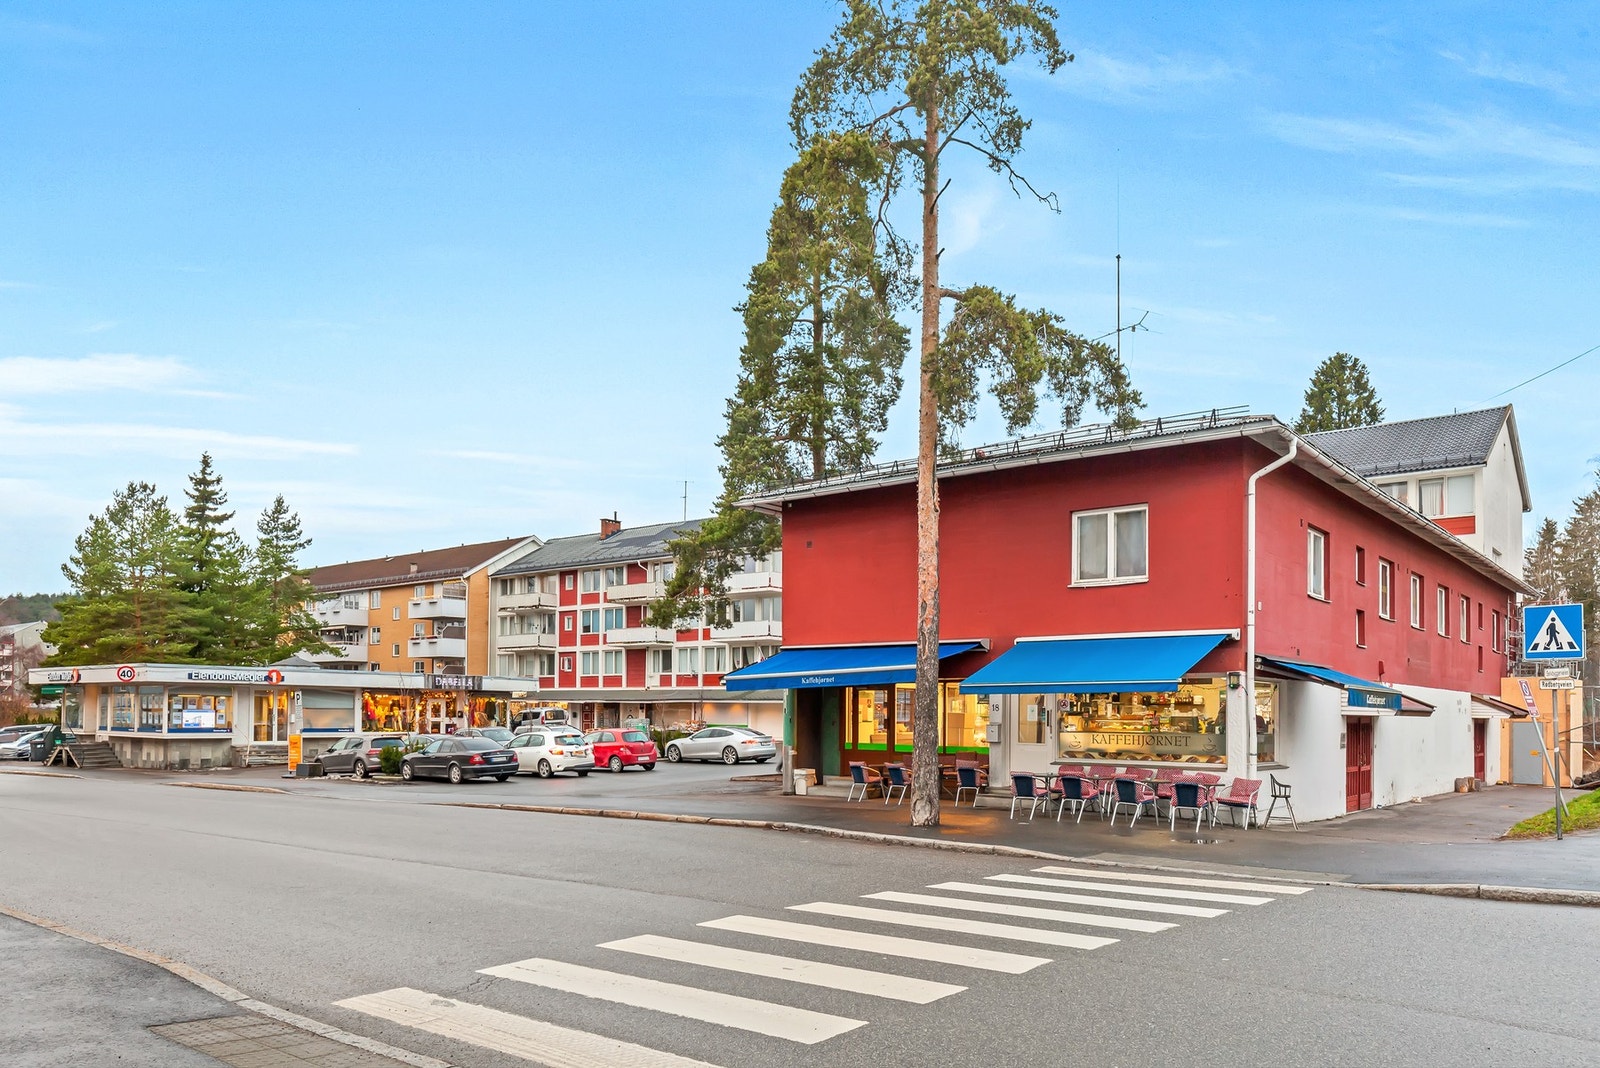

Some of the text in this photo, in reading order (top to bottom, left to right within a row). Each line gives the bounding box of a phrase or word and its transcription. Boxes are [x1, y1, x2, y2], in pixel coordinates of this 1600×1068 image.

[120, 670, 133, 678] 40
[992, 703, 1000, 712] 18
[1091, 733, 1192, 748] KAFFEHJØRNET
